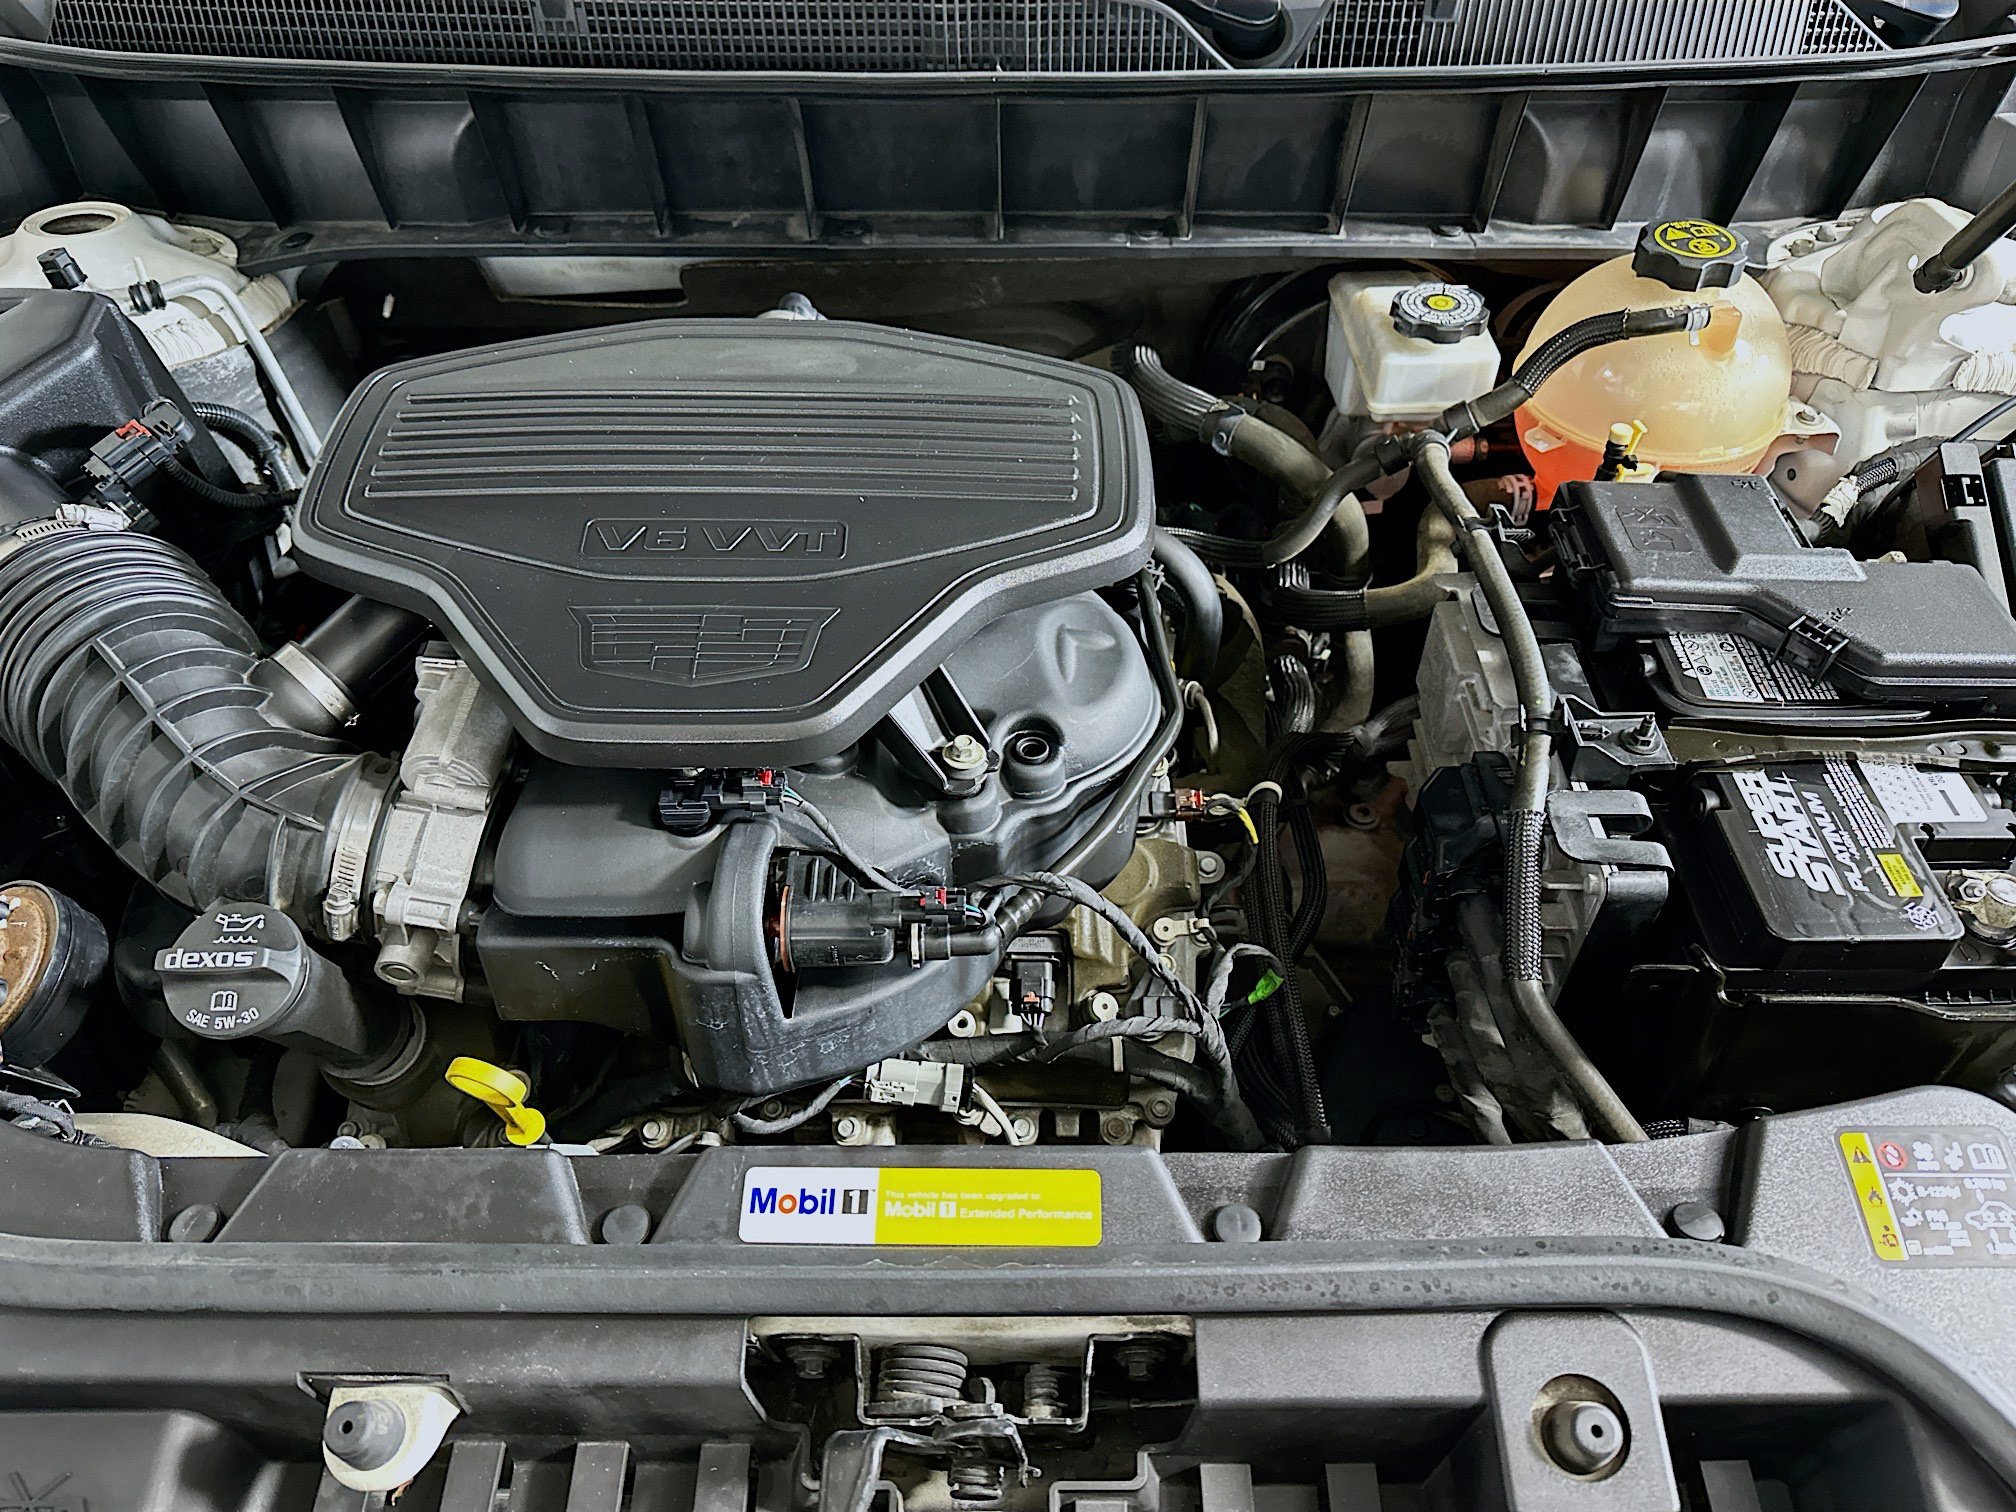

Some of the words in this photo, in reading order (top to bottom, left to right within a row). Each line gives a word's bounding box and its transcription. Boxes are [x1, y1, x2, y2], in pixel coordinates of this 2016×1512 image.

[595, 526, 687, 551] V6
[702, 526, 837, 552] VVT
[1733, 772, 1797, 878] SUPER
[1757, 769, 1846, 896] START
[1801, 791, 1870, 892] PLATINUM
[164, 948, 254, 969] dexos
[185, 1008, 211, 1028] SAE
[213, 1007, 260, 1030] 5W-30
[749, 1187, 836, 1215] Mobil
[844, 1190, 867, 1214] 1
[884, 1200, 937, 1218] Mobil
[940, 1201, 956, 1218] 1
[960, 1207, 1015, 1219] Extended
[1018, 1207, 1093, 1220] Performance
